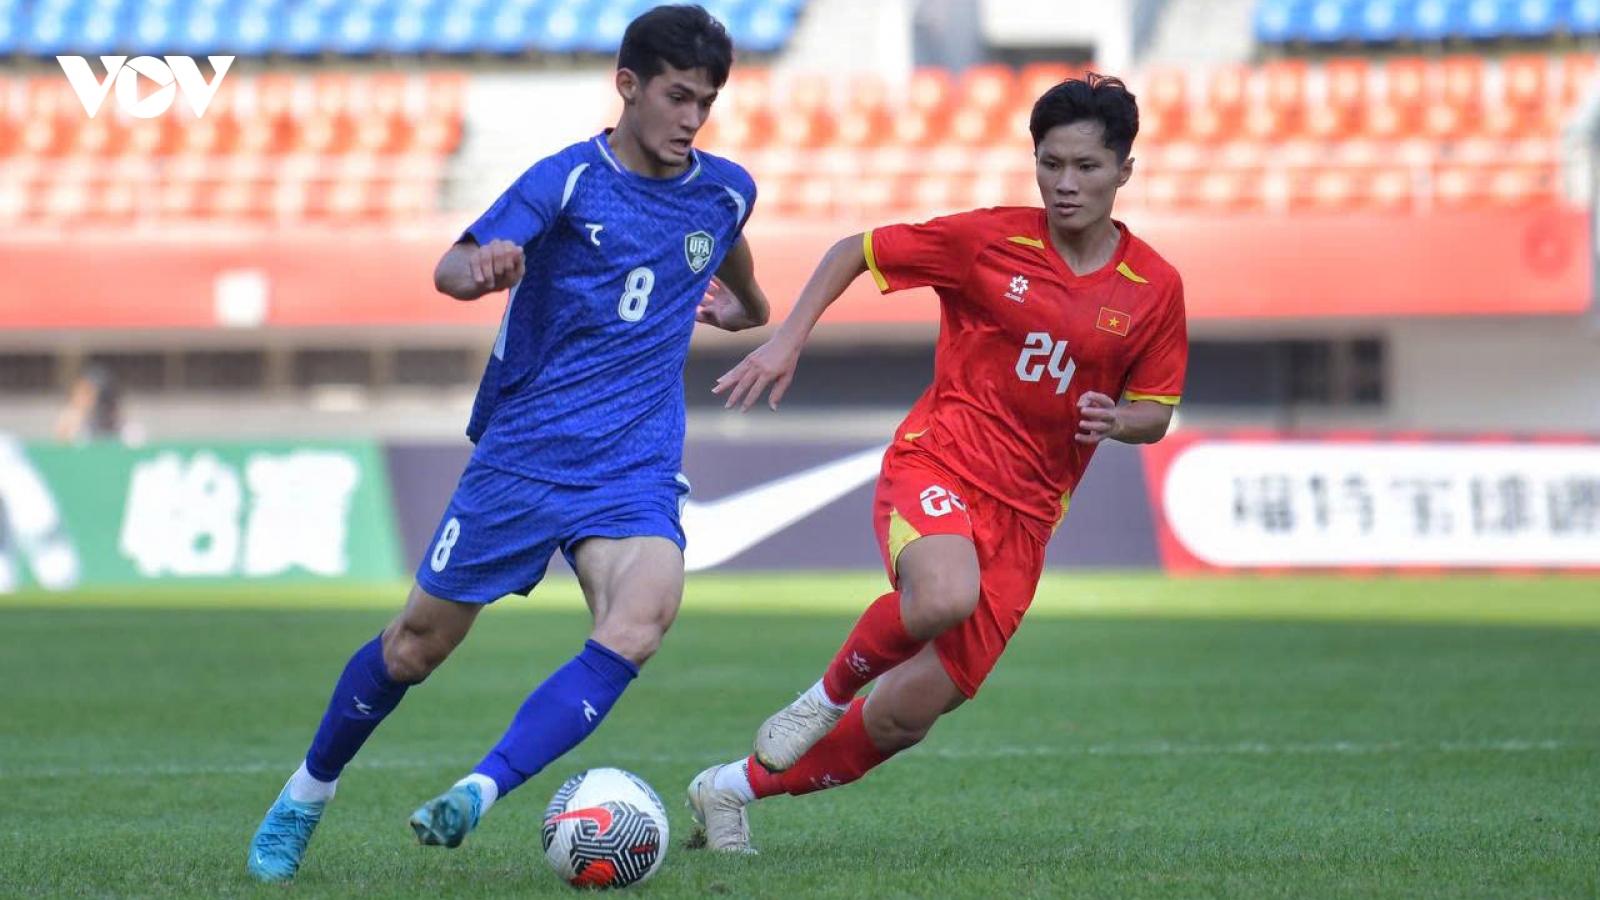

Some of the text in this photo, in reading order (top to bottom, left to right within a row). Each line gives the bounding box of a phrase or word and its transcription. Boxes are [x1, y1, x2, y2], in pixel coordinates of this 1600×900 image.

[689, 238, 711, 256] UFA
[618, 266, 655, 322] 8
[1015, 332, 1076, 395] 24
[430, 517, 461, 573] 8
